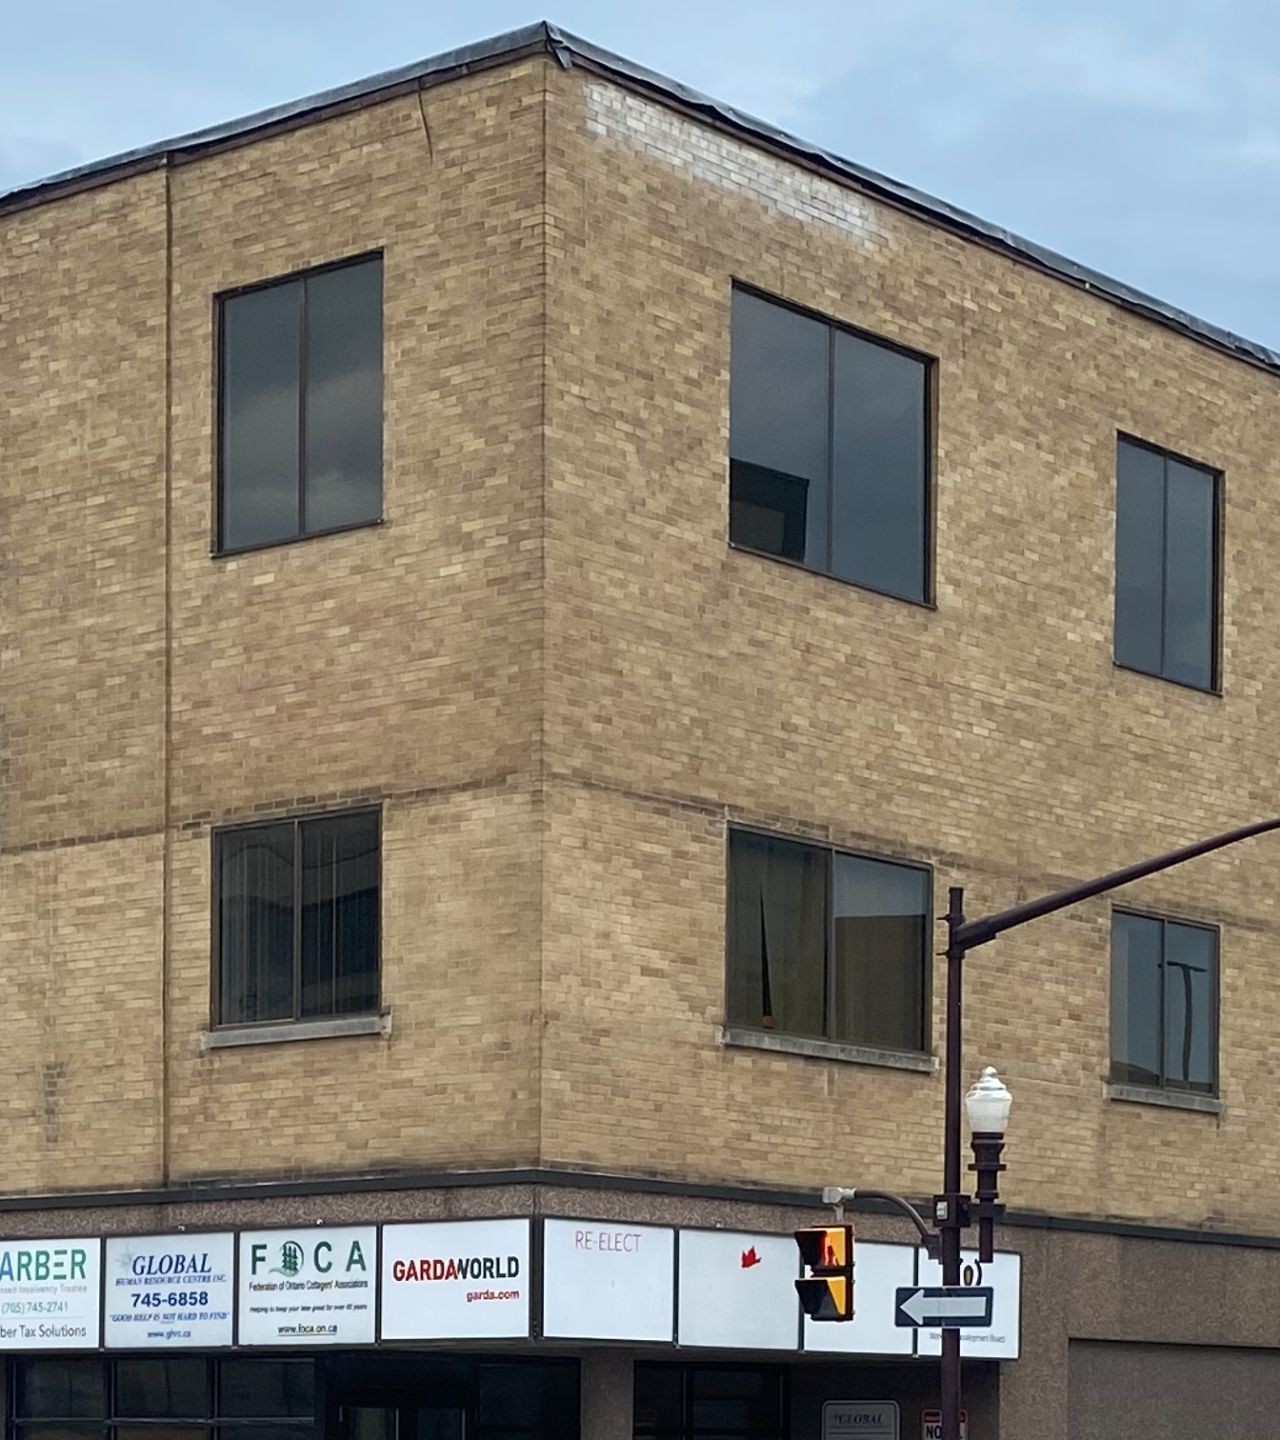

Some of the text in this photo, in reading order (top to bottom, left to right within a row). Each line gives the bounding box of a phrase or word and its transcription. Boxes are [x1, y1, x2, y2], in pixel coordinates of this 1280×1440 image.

[575, 1230, 643, 1252] RE-ELECT
[131, 1253, 212, 1276] GLOBAL
[392, 1256, 520, 1281] GARDAWORLD
[249, 1281, 278, 1292] Federation
[278, 1280, 285, 1291] of
[334, 1279, 368, 1289] Associations
[131, 1291, 209, 1307] 745-6858
[466, 1290, 520, 1303] garda.com
[1, 1301, 69, 1315] (705) 745-2741
[19, 1324, 36, 1337] Tax
[38, 1323, 87, 1337] Solutions
[277, 1323, 338, 1334] www.foca.on.ca
[926, 1424, 943, 1440] NO
